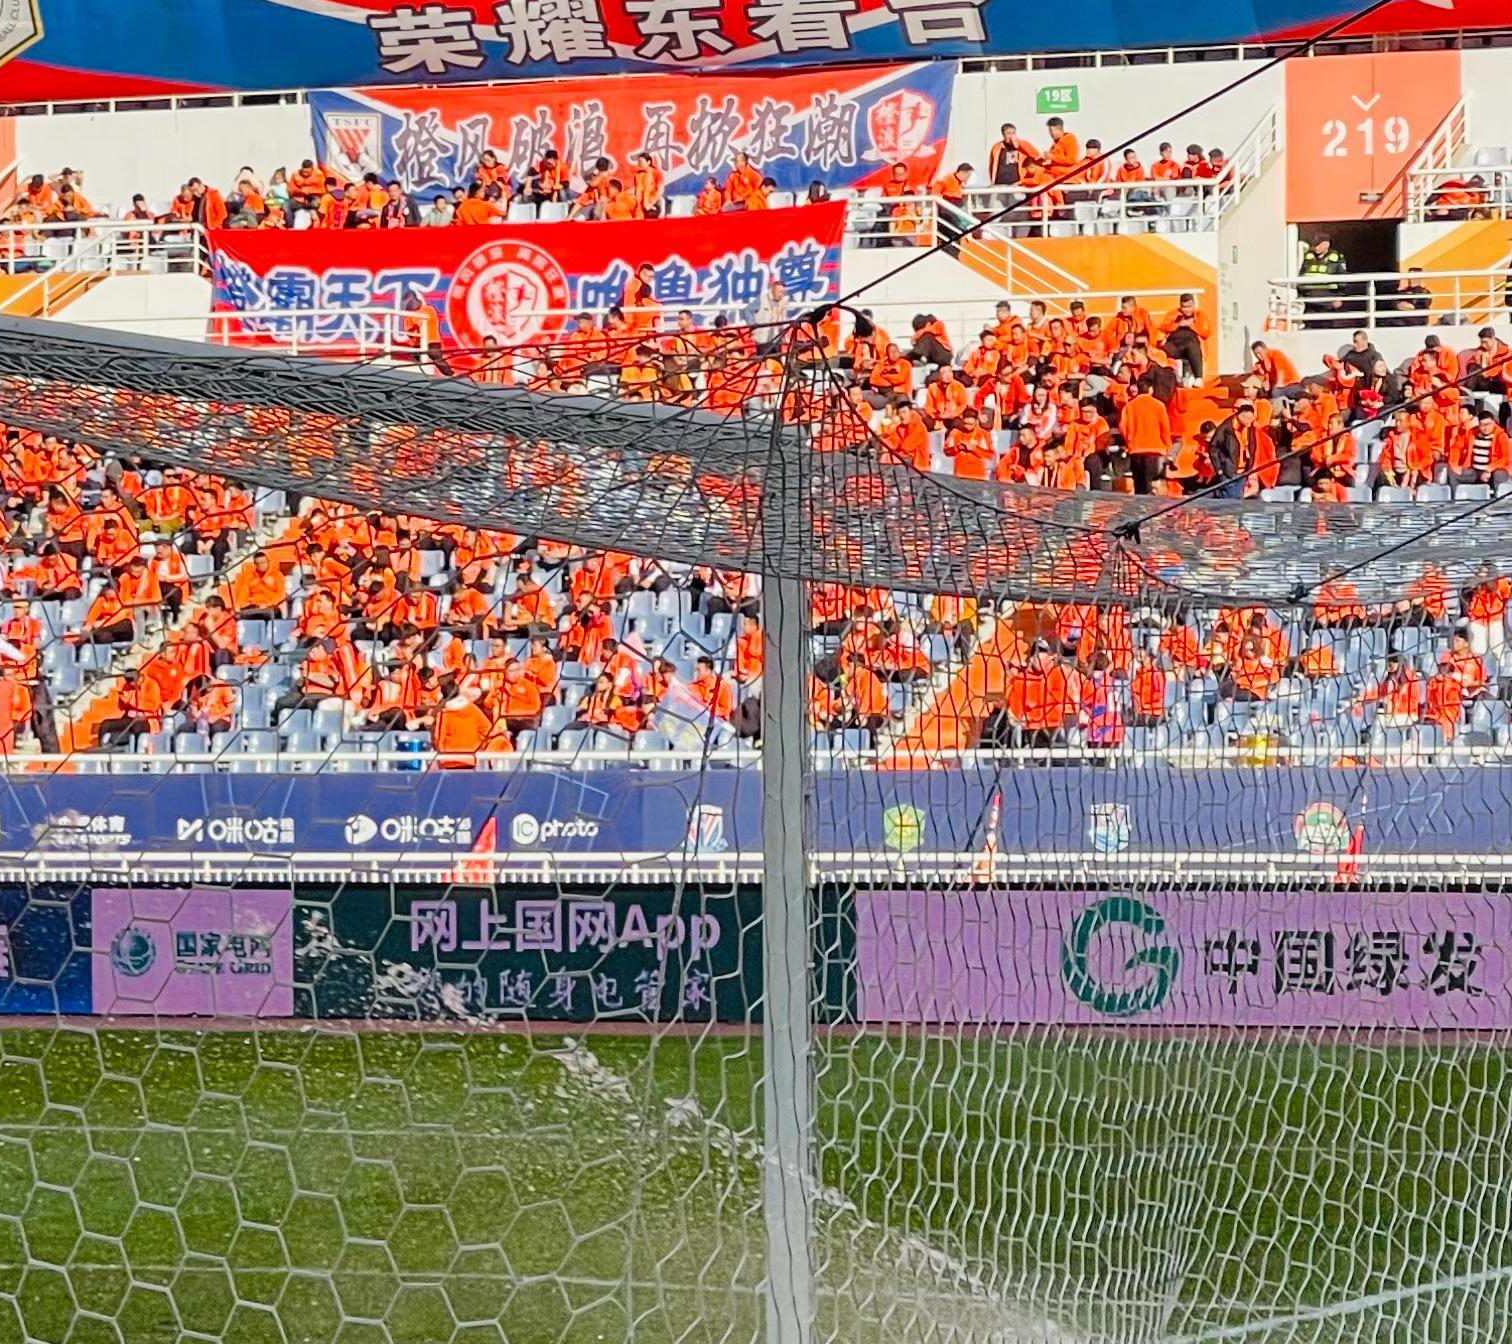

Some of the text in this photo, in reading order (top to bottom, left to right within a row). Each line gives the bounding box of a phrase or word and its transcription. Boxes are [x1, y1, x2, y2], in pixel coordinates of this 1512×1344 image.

[1322, 116, 1410, 157] 219
[1203, 929, 1485, 997] 中国绿发
